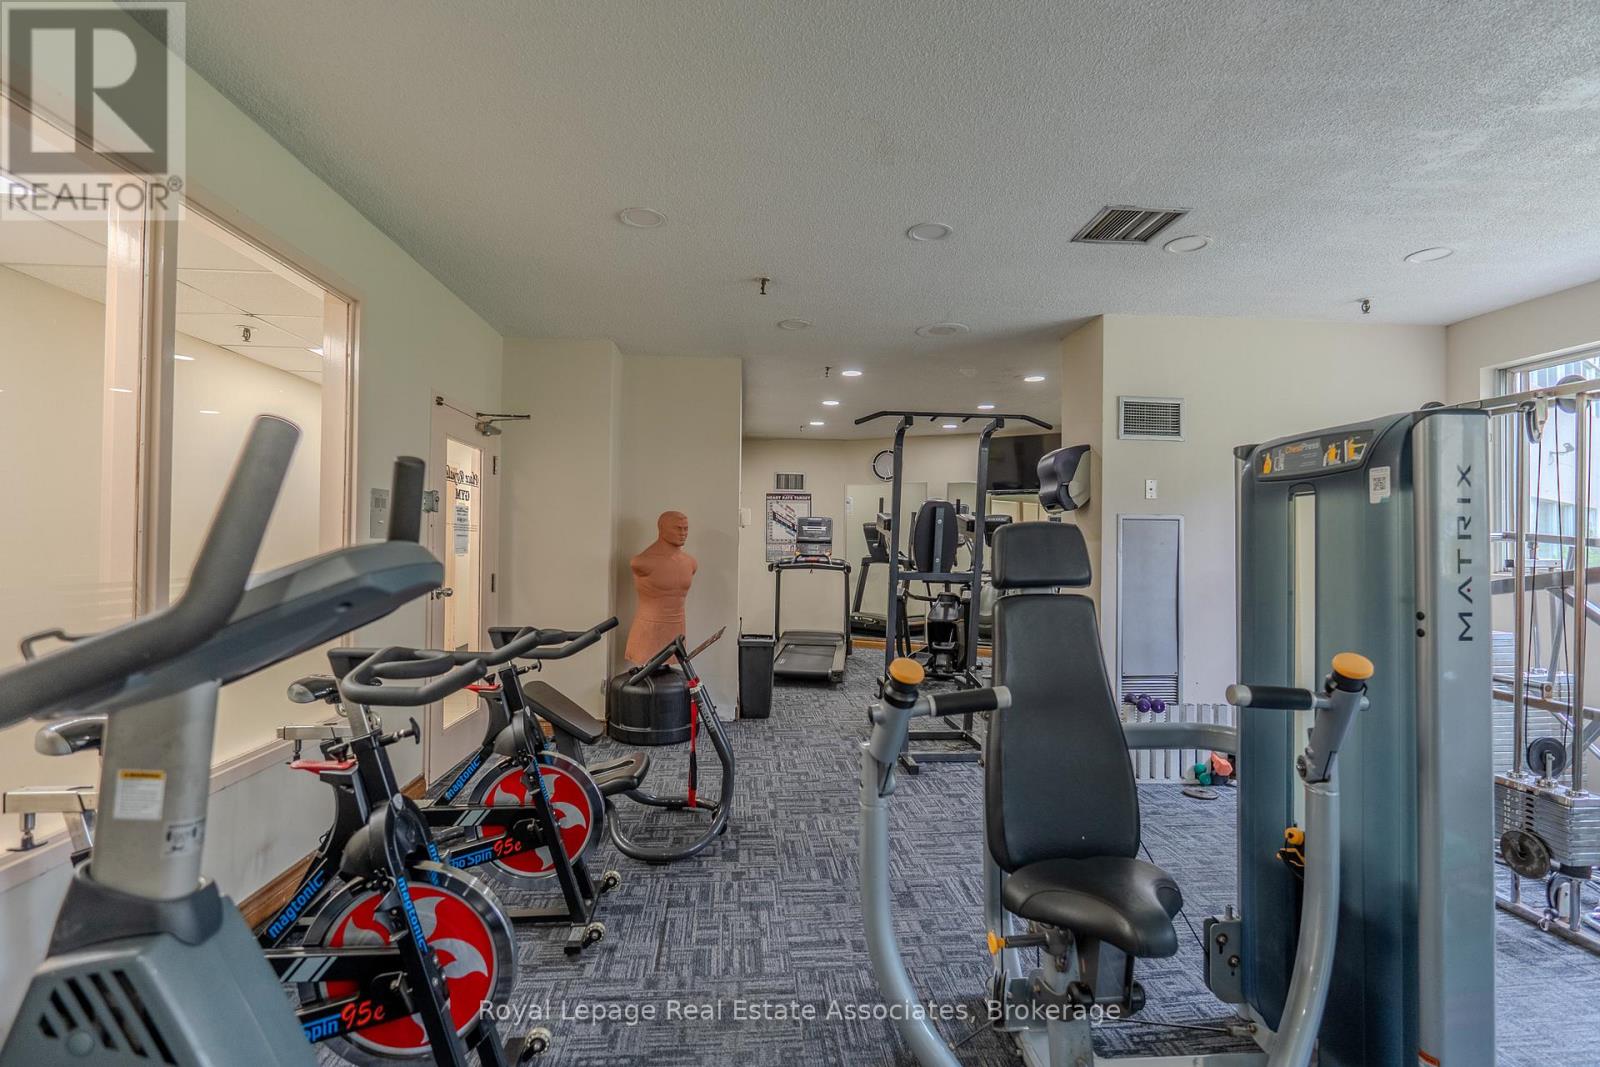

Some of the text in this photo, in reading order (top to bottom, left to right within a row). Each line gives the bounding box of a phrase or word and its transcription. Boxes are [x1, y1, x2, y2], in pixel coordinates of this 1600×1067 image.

[1457, 464, 1473, 641] MATRIX
[445, 755, 481, 800] magtonic
[268, 870, 325, 938] magtonic
[398, 876, 428, 954] magtonic
